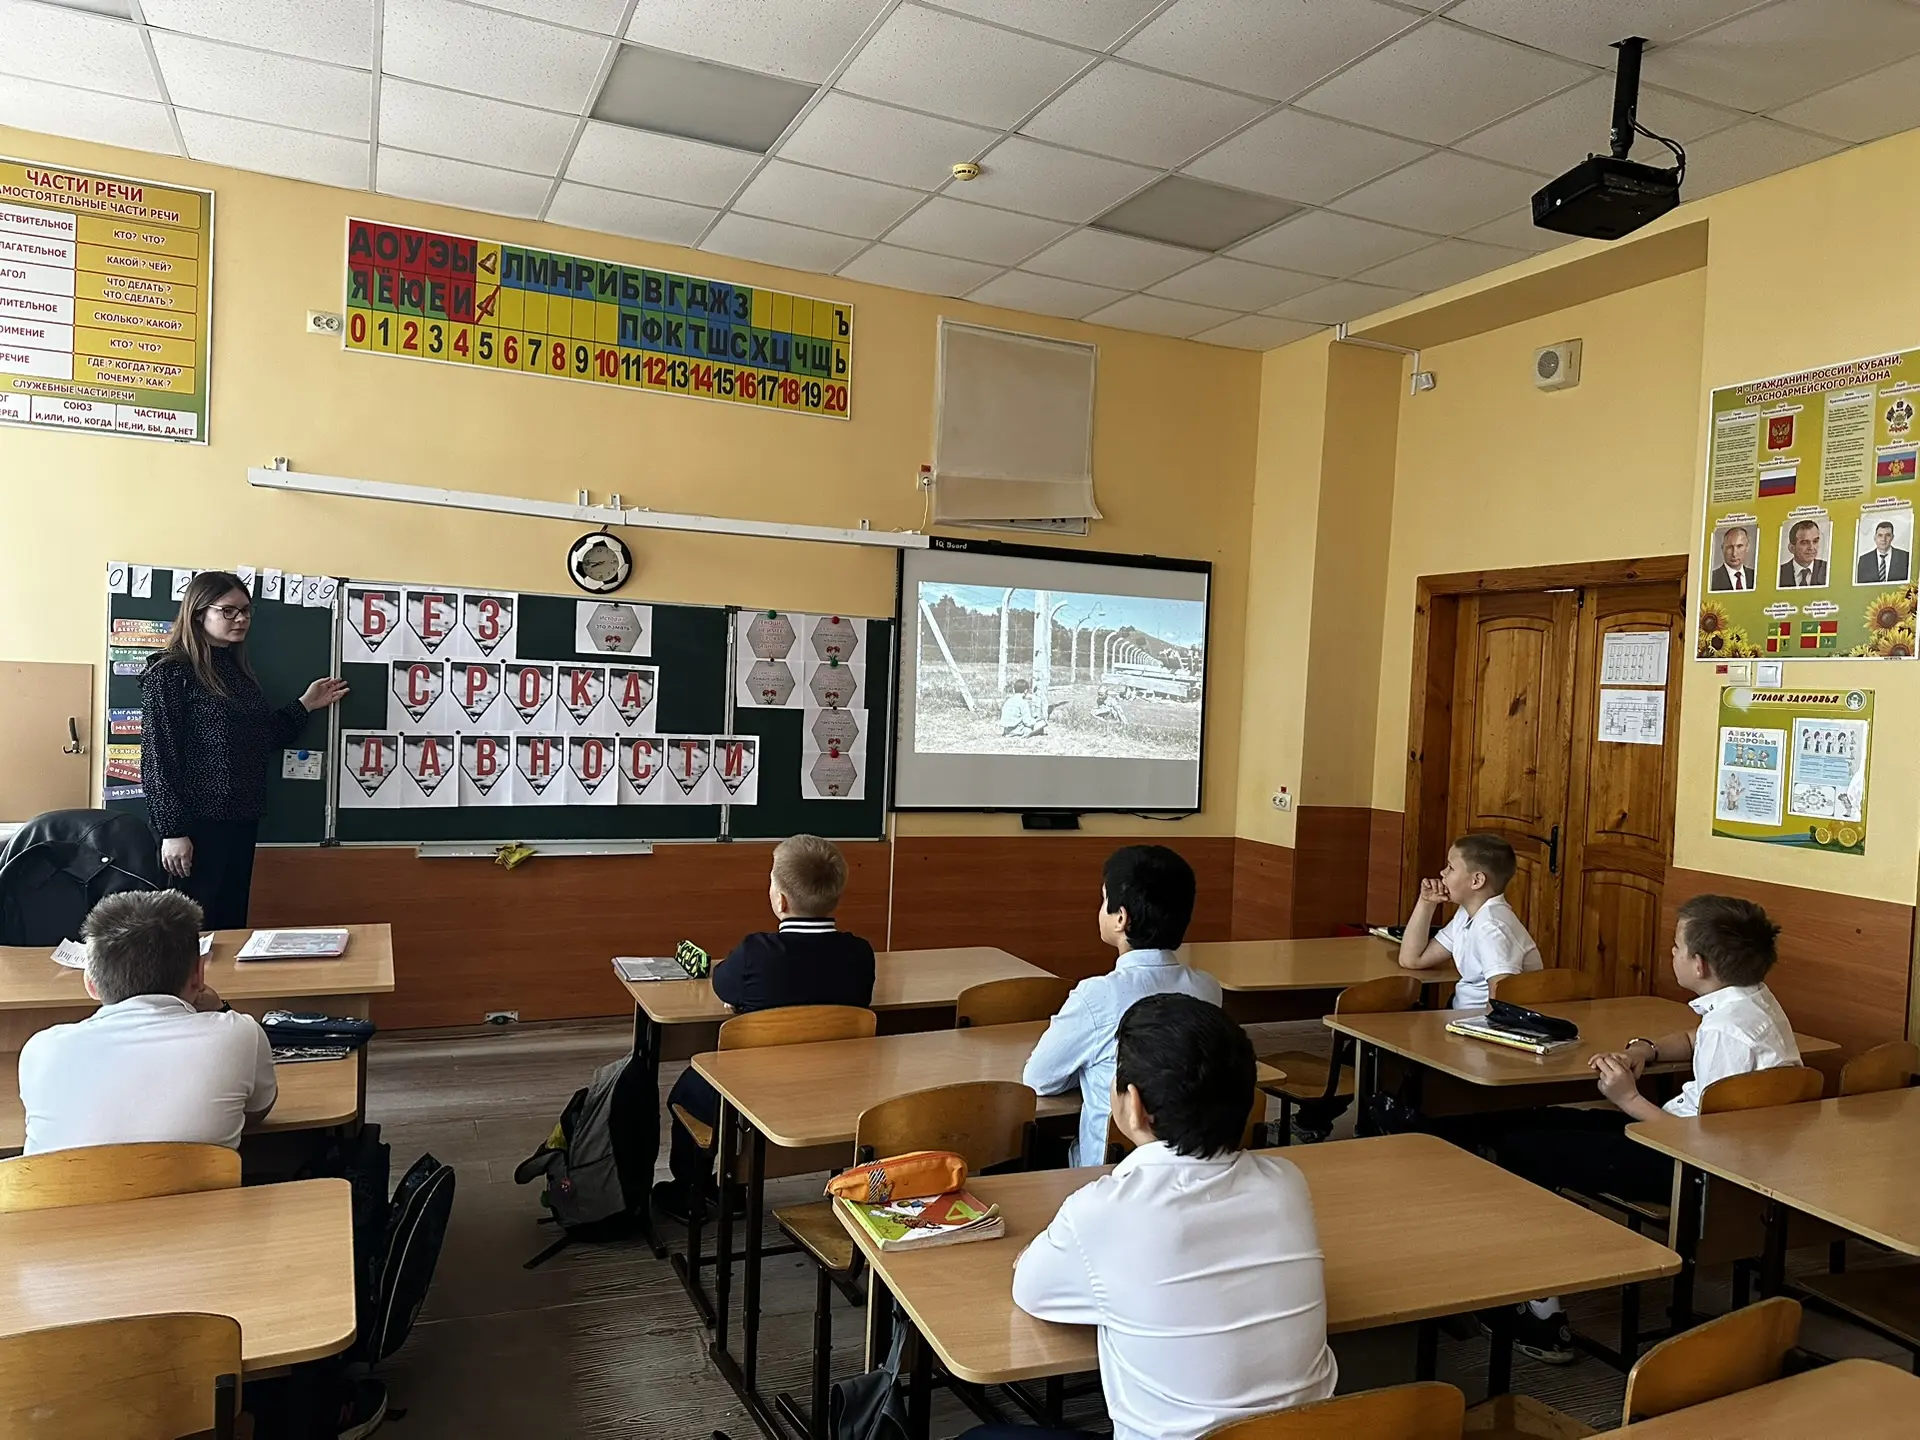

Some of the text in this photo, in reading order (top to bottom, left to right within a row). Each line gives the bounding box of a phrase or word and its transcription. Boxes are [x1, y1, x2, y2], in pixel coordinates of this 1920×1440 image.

[27, 170, 143, 202] ЧАСТИ РЕЧИ
[110, 203, 147, 217] ЧАСТИ
[150, 209, 179, 222] РЕЧИ
[113, 230, 165, 245] КТО? ЧТО?
[148, 261, 172, 272] ЧЕЙ?
[107, 277, 126, 288] ЧТО
[127, 280, 164, 293] ДЕЛАТЬ
[103, 290, 122, 300] ЧТО
[124, 292, 166, 306] СДЕЛАТЬ
[94, 311, 183, 330] СКОЛЬКО? КАКОЙ?
[110, 339, 162, 353] КТО? ЧТО?
[87, 357, 105, 367] ГДЕ
[115, 361, 150, 374] КОГДА?
[152, 365, 182, 376] КУДА?
[351, 314, 848, 412] 0 1 2 3 4 5 6 7 8 9 10 11 12 13 14 15 16 17 18 19 20
[97, 372, 135, 384] ПОЧЕМУ
[145, 378, 164, 388] КАК
[1736, 386, 1743, 395] Я
[1751, 374, 1810, 393] ГРАЖДАНИН
[1811, 365, 1855, 382] РОССИИ,
[1857, 355, 1903, 372] КУБАНИ,
[13, 379, 135, 401] СЛУЖЕБНЫЕ ЧАСТИ РЕЧИ
[1745, 378, 1846, 405] КРАСНОАРМЕЙСКОГО
[1848, 369, 1891, 386] РАЙОНА
[63, 401, 92, 412] СОЮЗ
[134, 408, 177, 421] ЧАСТИЦА
[84, 417, 112, 428] КОГДА
[935, 539, 968, 550] IQ Board
[109, 569, 124, 587] 0
[138, 572, 148, 590] 1
[176, 576, 191, 594] 2
[266, 575, 281, 592] 5
[290, 580, 302, 597] 7
[307, 582, 318, 600] 8
[319, 584, 335, 599] 9
[362, 592, 501, 641] БЕЗ
[408, 664, 642, 709] СРОКА
[1751, 693, 1839, 704] УГОЛОК ЗДОРОВЬЯ
[1727, 737, 1777, 746] ЗДОРОВЬЯ
[1728, 730, 1765, 739] АЗБУКА
[359, 737, 743, 780] ДАВНОСТИ
[112, 788, 143, 797] МУЗЫК
